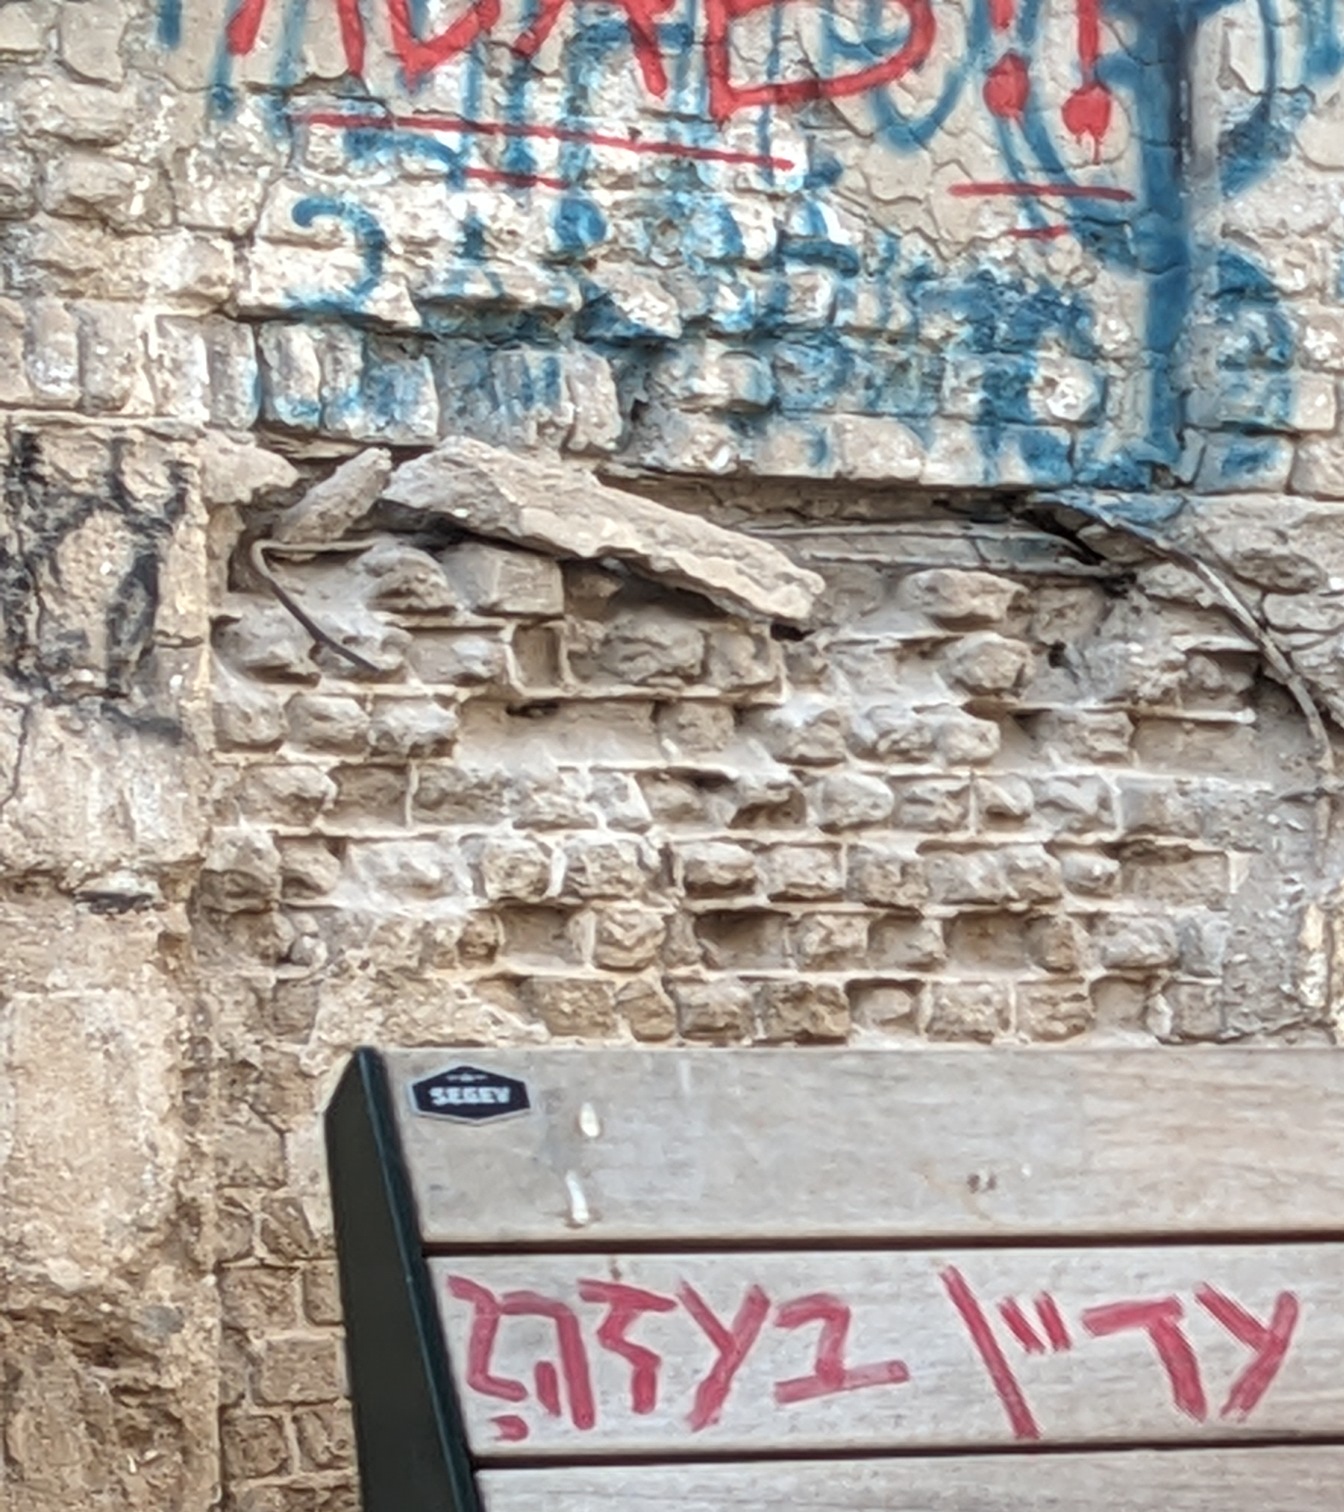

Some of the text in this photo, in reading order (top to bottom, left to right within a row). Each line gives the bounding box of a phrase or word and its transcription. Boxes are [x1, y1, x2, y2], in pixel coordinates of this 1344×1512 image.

[428, 1085, 511, 1106] SEGEV
[447, 1275, 908, 1442] בעזה?
[942, 1266, 1299, 1440] עדיין
